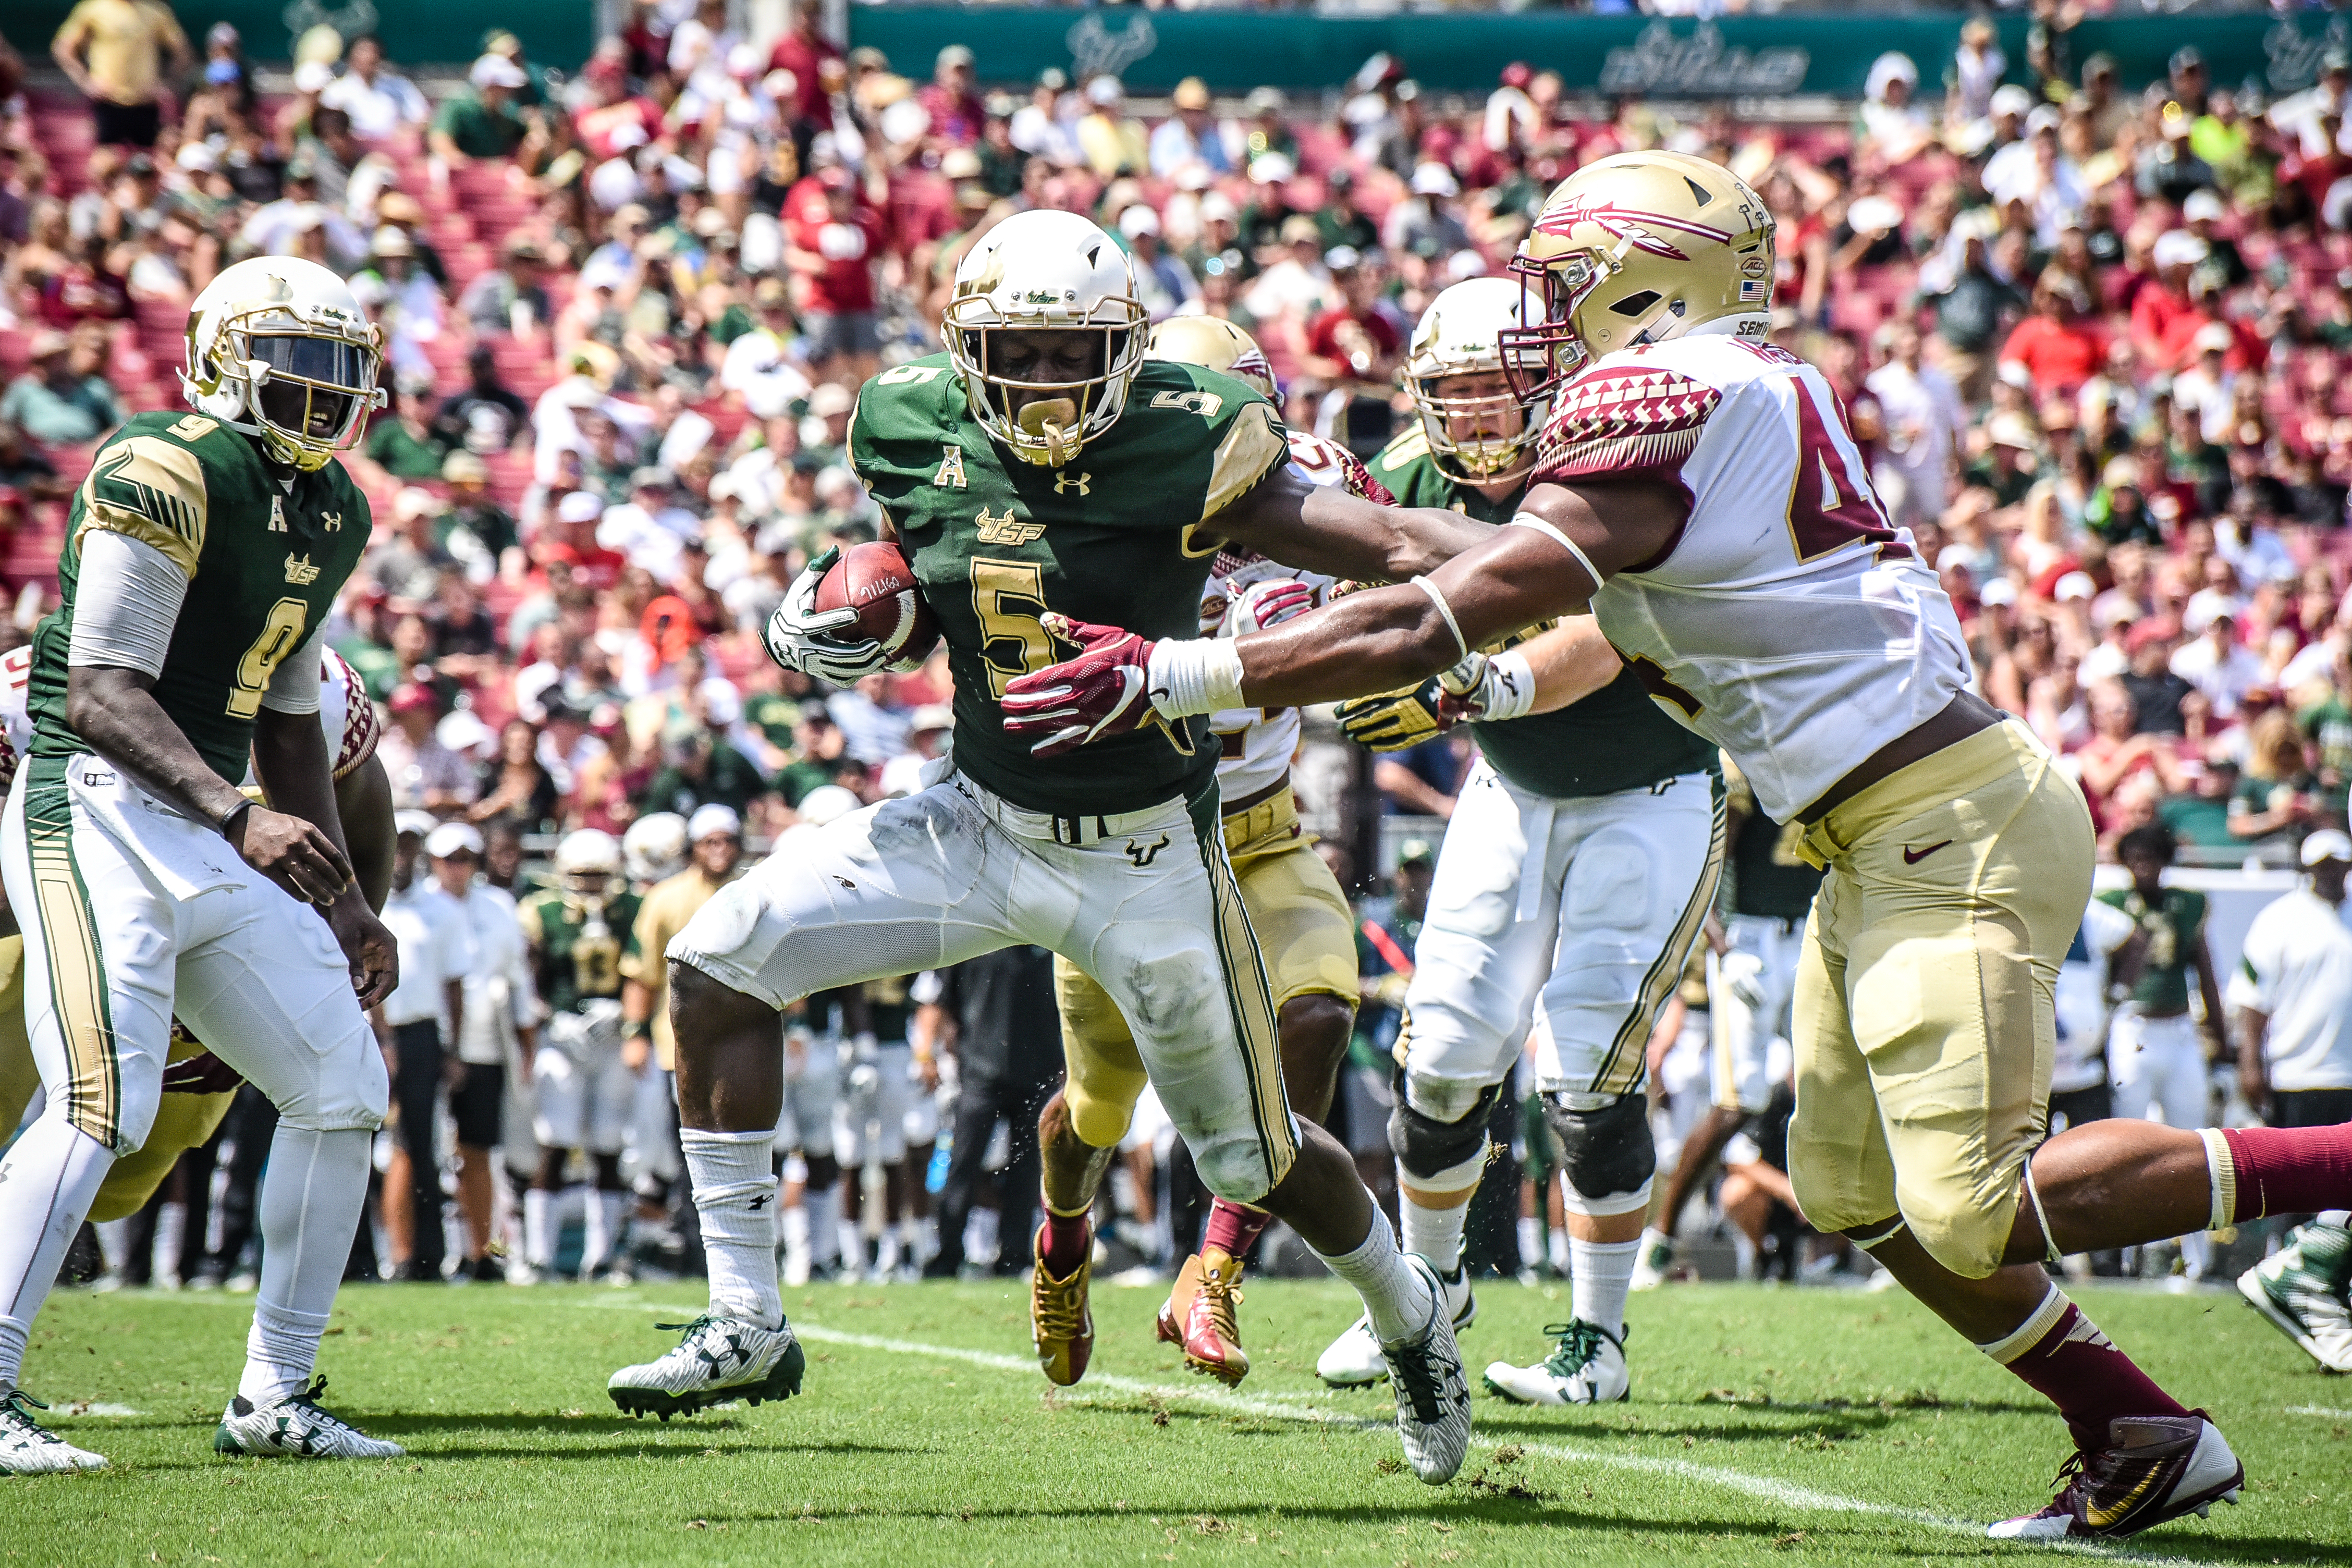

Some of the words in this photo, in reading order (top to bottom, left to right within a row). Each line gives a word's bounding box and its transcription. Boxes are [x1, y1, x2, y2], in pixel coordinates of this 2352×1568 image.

[1026, 289, 1061, 304] USF
[1149, 390, 1223, 416] 5
[165, 414, 220, 442] 9
[934, 445, 967, 488] A
[267, 495, 289, 532] A
[975, 506, 1047, 546] USF
[285, 551, 320, 585] USF
[970, 556, 1058, 702] 5
[225, 597, 308, 720] 9
